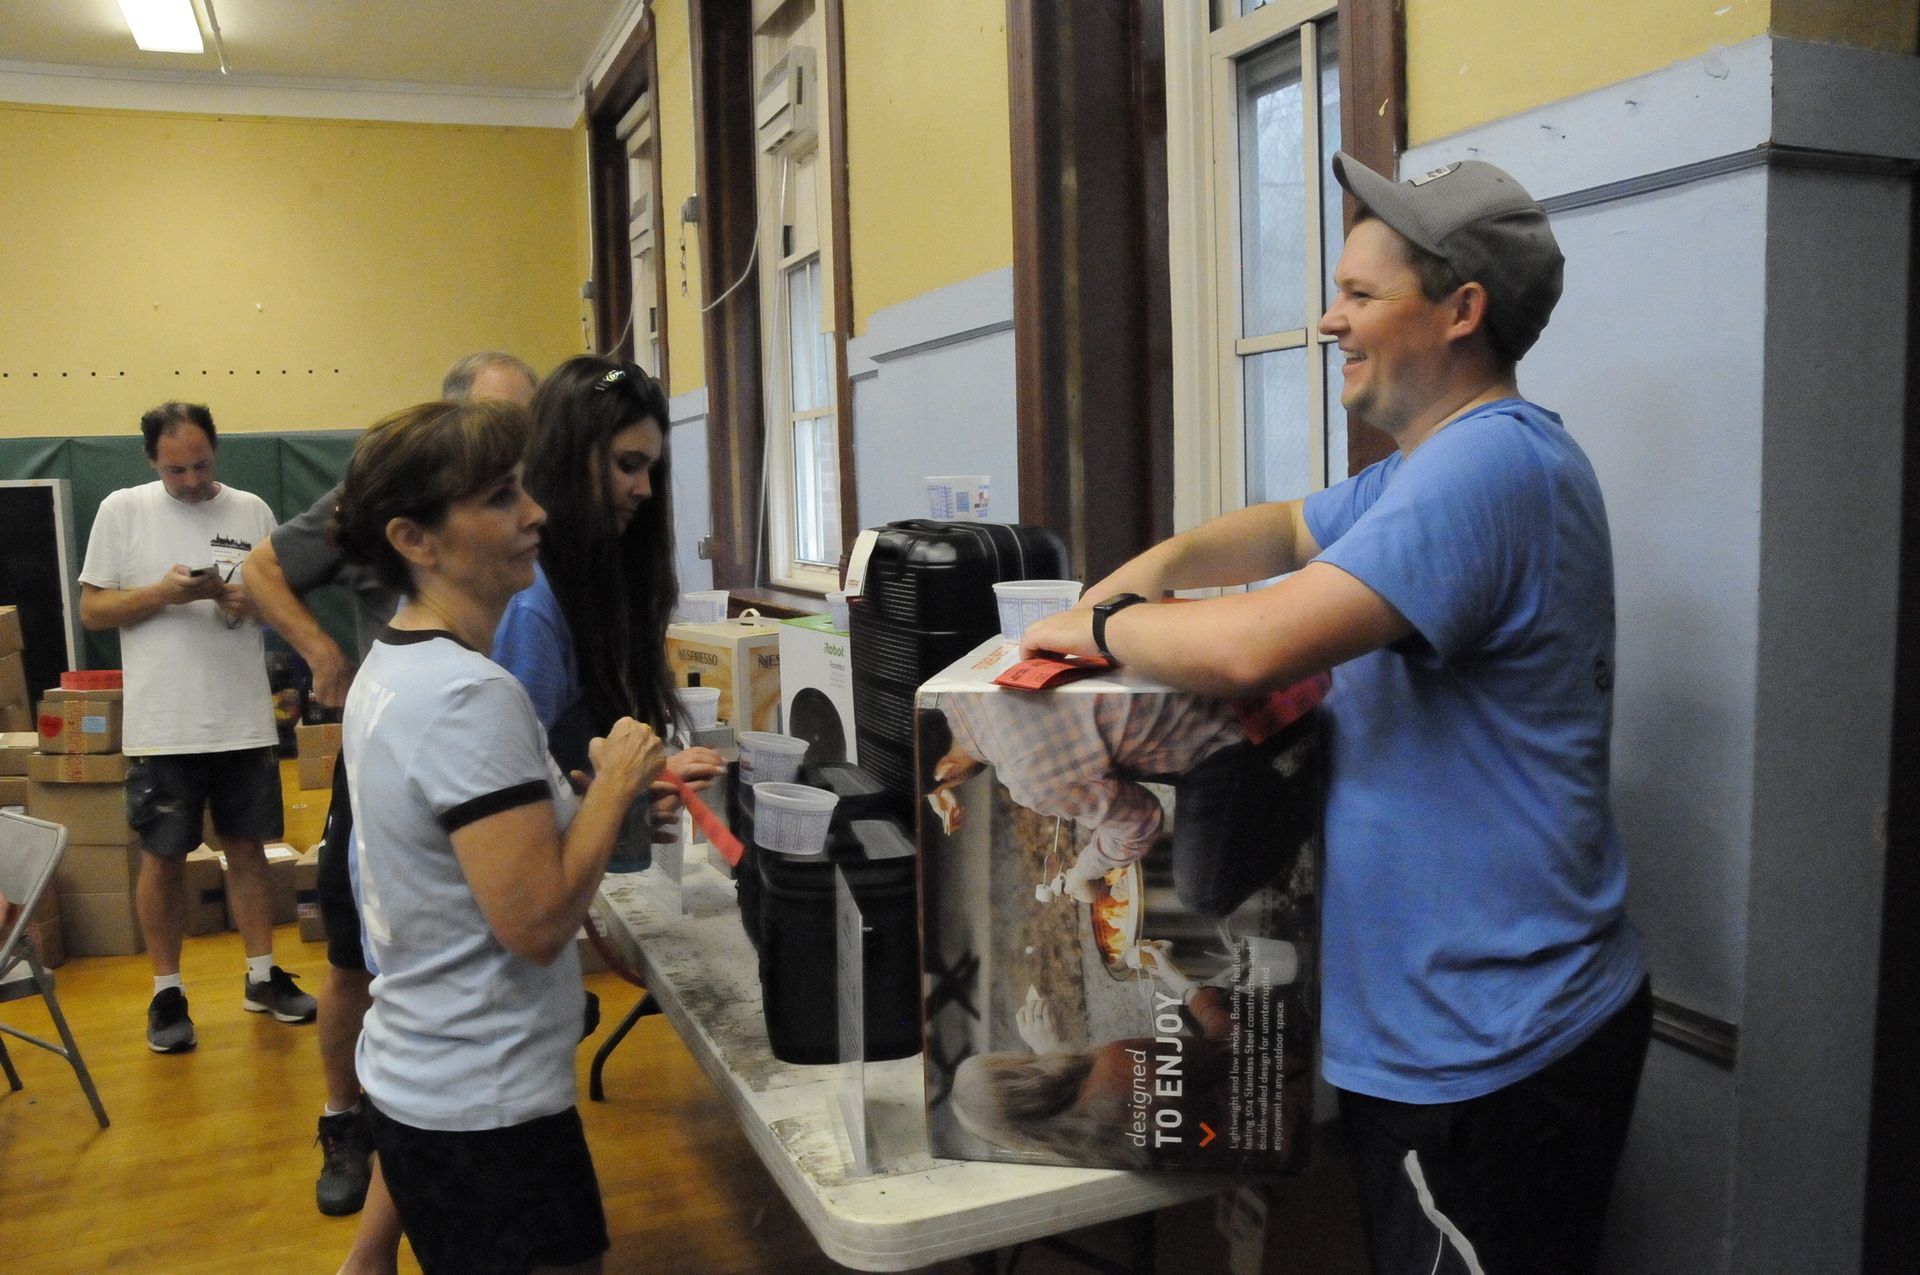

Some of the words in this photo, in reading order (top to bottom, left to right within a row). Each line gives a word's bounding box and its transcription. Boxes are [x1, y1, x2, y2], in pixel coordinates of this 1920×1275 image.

[678, 648, 718, 666] NESPRESSO
[1231, 985, 1240, 1019] Bonfire
[1246, 968, 1255, 1027] construction
[1260, 968, 1271, 1034] uninterrupted
[1276, 1000, 1285, 1030] space.
[1155, 992, 1182, 1096] ENJOY
[1245, 1030, 1254, 1054] Steel
[1259, 1037, 1268, 1050] for
[1275, 1033, 1283, 1070] outdoor
[1231, 1058, 1239, 1074] low
[1244, 1057, 1254, 1097] Stainless
[1259, 1053, 1270, 1083] design
[1275, 1073, 1284, 1089] any
[1125, 1048, 1152, 1147] designed
[1230, 1077, 1239, 1093] and
[1274, 1092, 1282, 1100] in
[1230, 1096, 1240, 1148] Lightweight
[1245, 1100, 1253, 1118] 304
[1155, 1110, 1182, 1148] TO
[1244, 1121, 1255, 1149] lasting
[1274, 1103, 1283, 1150] enjoyment
